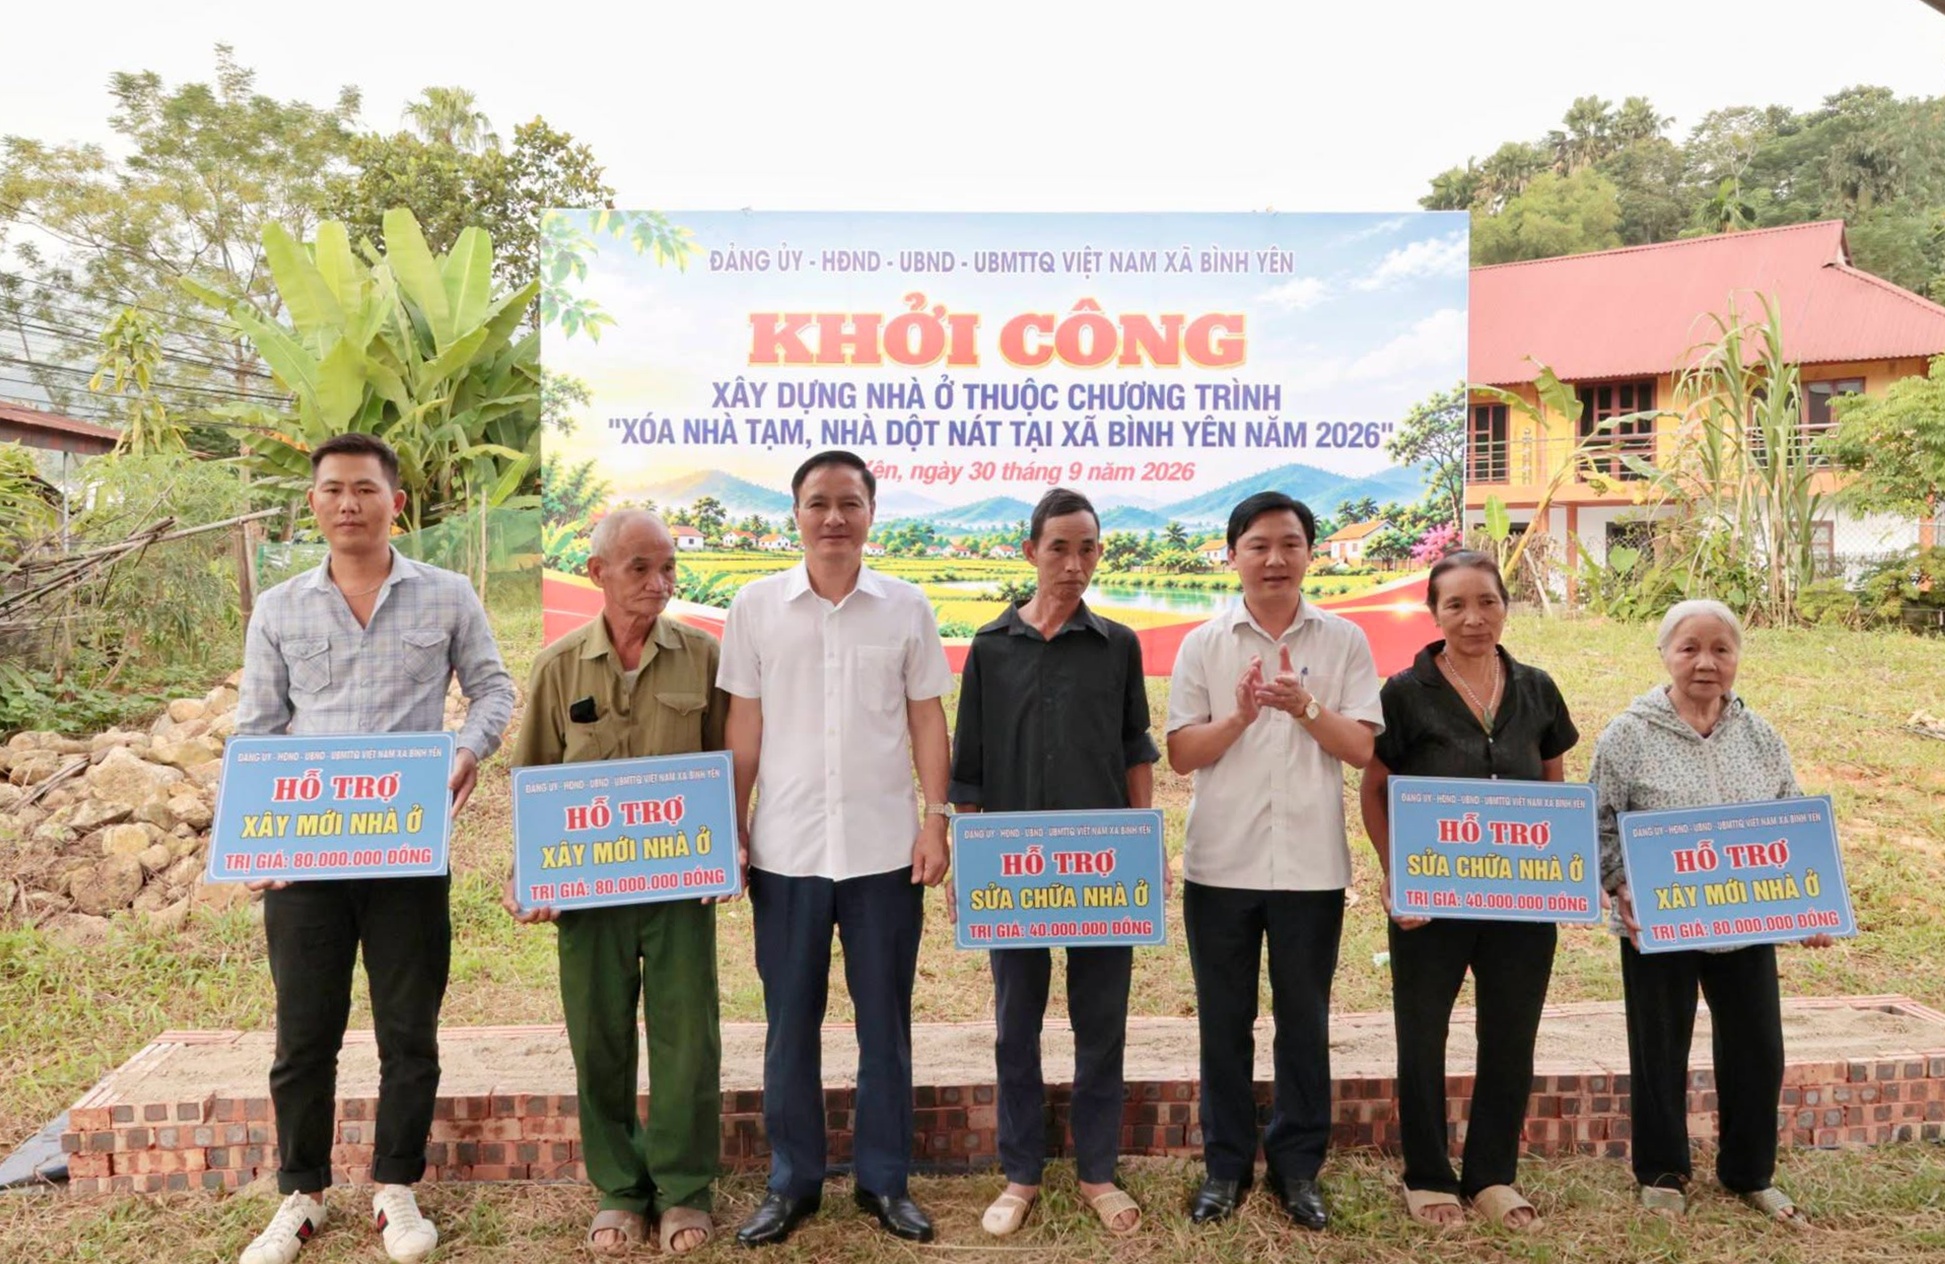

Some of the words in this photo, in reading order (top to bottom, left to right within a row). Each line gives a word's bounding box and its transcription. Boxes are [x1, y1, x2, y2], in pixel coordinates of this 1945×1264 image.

[709, 242, 770, 272] ĐẢNG
[778, 242, 803, 272] ỦY
[822, 250, 881, 272] HĐND
[900, 250, 955, 273] UBND
[974, 251, 1056, 274] UBMTTQ
[1062, 245, 1103, 279] VIỆT
[1109, 251, 1157, 273] NAM
[1164, 245, 1193, 273] XÃ
[1200, 245, 1249, 273] BÌNH
[1256, 245, 1294, 273] YÊN
[748, 291, 980, 367] KHỞI
[999, 297, 1247, 369] CÔNG
[712, 376, 768, 409] XÂY
[778, 379, 856, 414] DỰNG
[866, 377, 925, 410] NHÀ
[935, 374, 955, 410] Ở
[963, 377, 1059, 416] THUỘC
[1068, 380, 1185, 411] CHƯƠNG
[1195, 378, 1281, 411] TRÌNH
[608, 412, 675, 445] "XÓA
[684, 412, 738, 445] NHÀ
[745, 418, 812, 450] TẠM,
[821, 413, 878, 446] NHÀ
[887, 413, 940, 452] DỘT
[948, 414, 1002, 446] NÁT
[1010, 420, 1052, 453] TẠI
[1061, 414, 1099, 447] XÃ
[1108, 414, 1174, 447] BÌNH
[1182, 415, 1236, 448] YÊN
[1245, 415, 1307, 448] NĂM
[1315, 421, 1394, 449] 2026"
[910, 460, 963, 485] ngày
[968, 461, 996, 481] 30
[1002, 460, 1062, 485] tháng
[1068, 462, 1082, 481] 9
[1087, 461, 1135, 481] năm
[1141, 461, 1196, 481] 2026
[272, 769, 321, 801] HỖ
[332, 773, 401, 801] TRỢ
[240, 811, 291, 839] XÂY
[296, 809, 343, 837] MỚI
[350, 807, 399, 835] NHÀ
[406, 803, 424, 834] Ở
[565, 795, 611, 831] HỖ
[620, 795, 684, 826] TRỢ
[1438, 812, 1481, 844] HỖ
[1489, 820, 1550, 849] TRỢ
[225, 853, 250, 873] TRỊ
[256, 850, 289, 869] GIÁ:
[294, 850, 382, 868] 80.000.000
[541, 840, 586, 869] XÂY
[592, 835, 636, 864] MỚI
[643, 831, 690, 860] NHÀ
[696, 824, 712, 855] Ở
[1001, 844, 1045, 876] HỖ
[1053, 849, 1116, 877] TRỢ
[1672, 839, 1718, 874] HỖ
[1725, 838, 1789, 870] TRỢ
[1407, 847, 1450, 877] SỬA
[1456, 851, 1513, 879] CHỮA
[1519, 855, 1564, 881] NHÀ
[1569, 853, 1584, 882] Ở
[530, 884, 554, 902] TRỊ
[560, 879, 590, 899] GIÁ:
[595, 874, 678, 895] 80.000.000
[970, 881, 1014, 911] SỬA
[1019, 881, 1077, 909] CHỮA
[1083, 881, 1128, 908] NHÀ
[1134, 879, 1149, 907] Ở
[1406, 890, 1429, 909] TRỊ
[1433, 890, 1461, 907] GIÁ:
[1465, 894, 1544, 910] 40.000.000
[1655, 882, 1698, 911] XÂY
[1703, 877, 1748, 906] MỚI
[1752, 872, 1800, 902] NHÀ
[1804, 868, 1820, 899] Ở
[969, 924, 992, 941] TRỊ
[997, 921, 1025, 938] GIÁ:
[1029, 921, 1108, 937] 40.000.000
[1652, 923, 1676, 943] TRỊ
[1680, 919, 1709, 940] GIÁ:
[1713, 914, 1793, 936] 80.000.000
